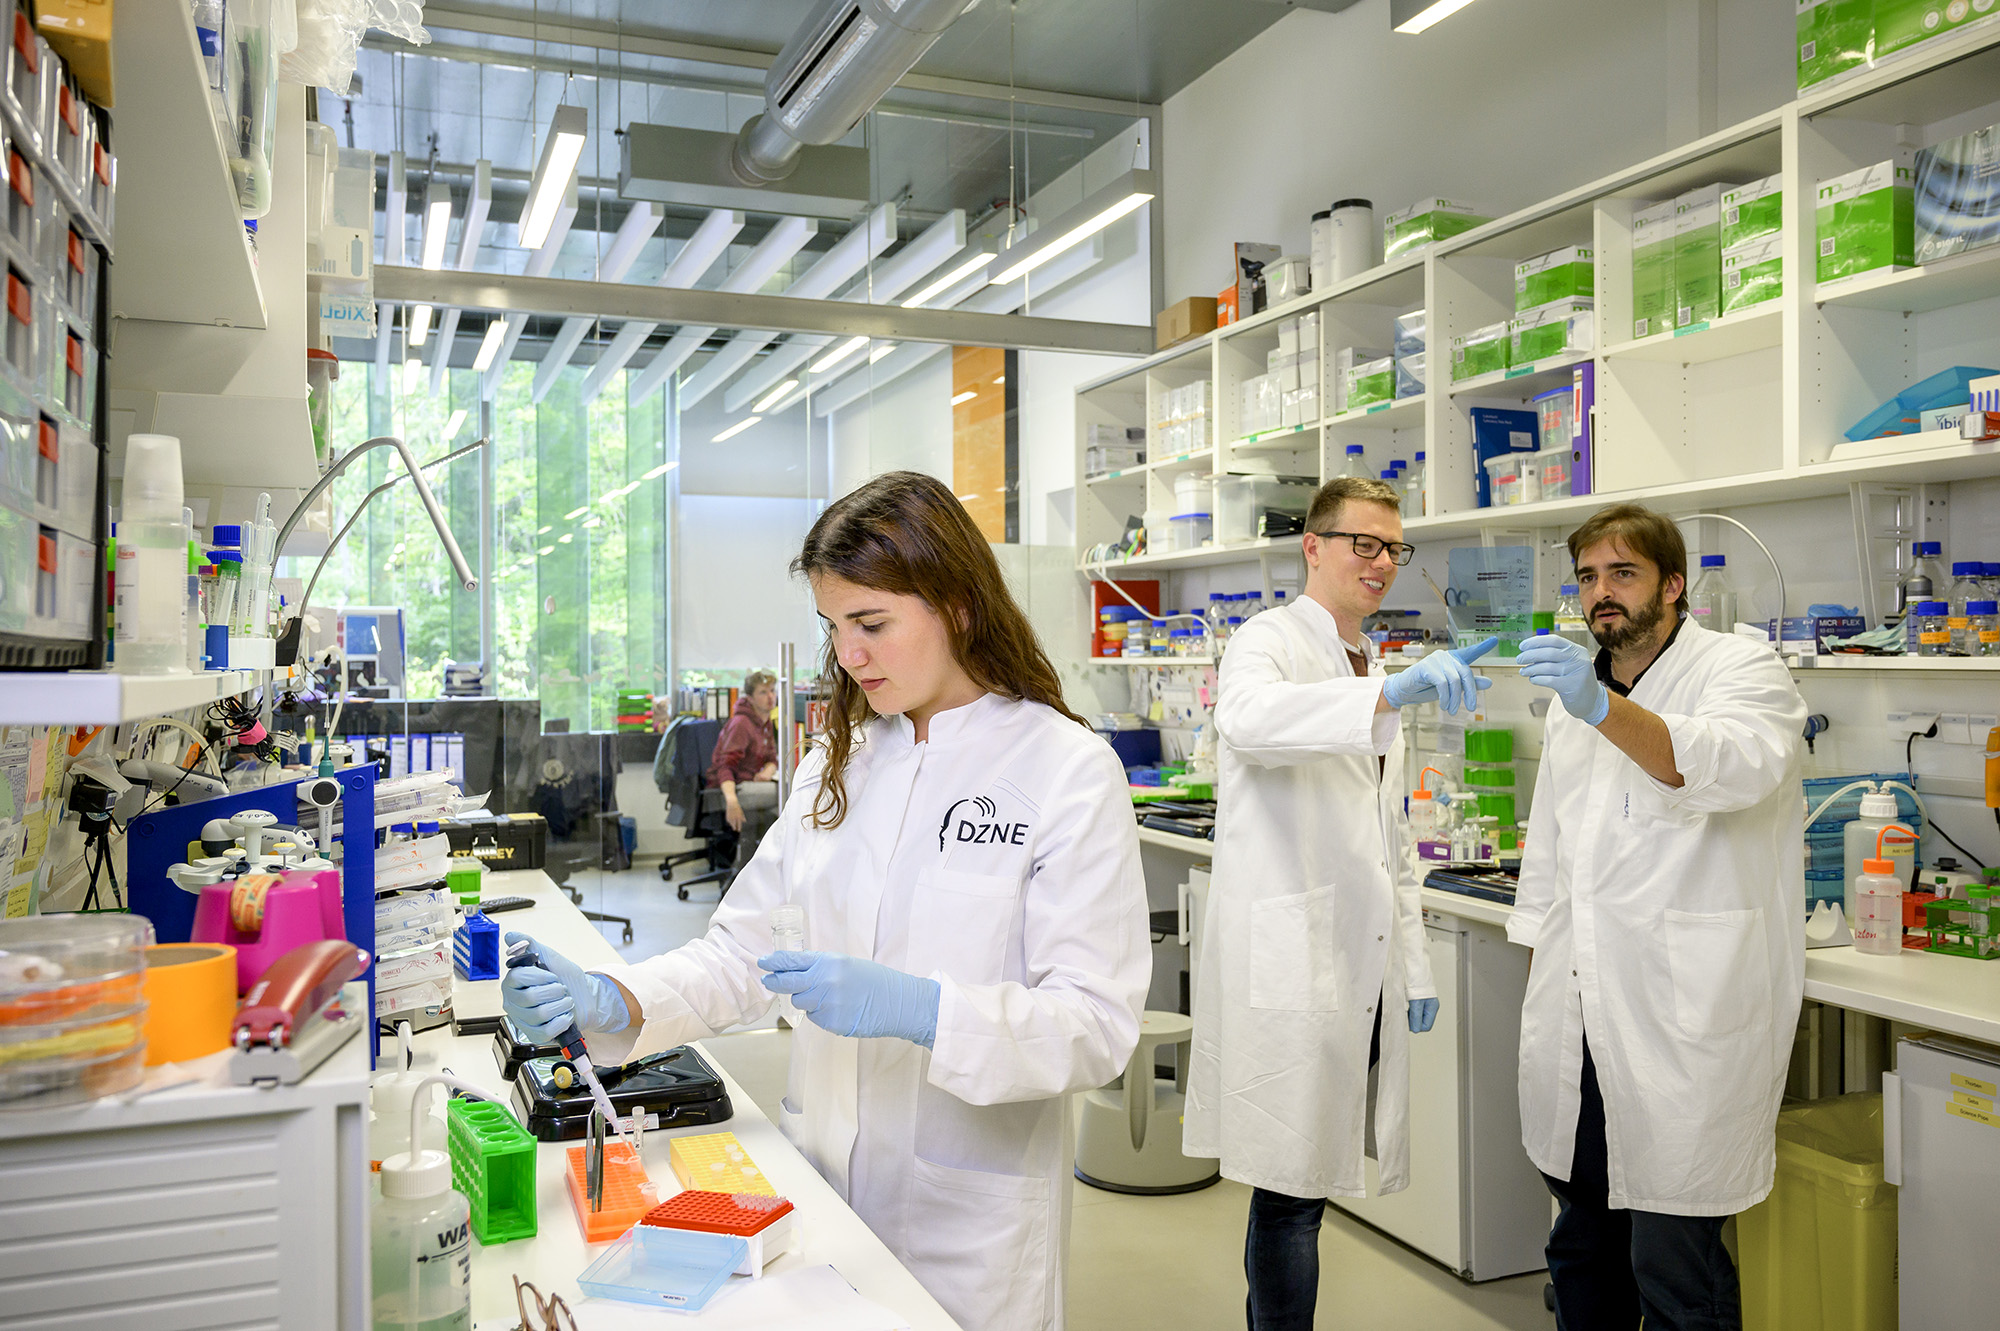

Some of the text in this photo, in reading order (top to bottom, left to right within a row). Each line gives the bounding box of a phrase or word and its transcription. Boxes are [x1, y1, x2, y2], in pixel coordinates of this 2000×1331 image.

[1936, 235, 1965, 249] BIOFIL
[1940, 416, 1960, 430] ibi
[956, 819, 1030, 846] DZNE
[453, 847, 515, 860] STEY
